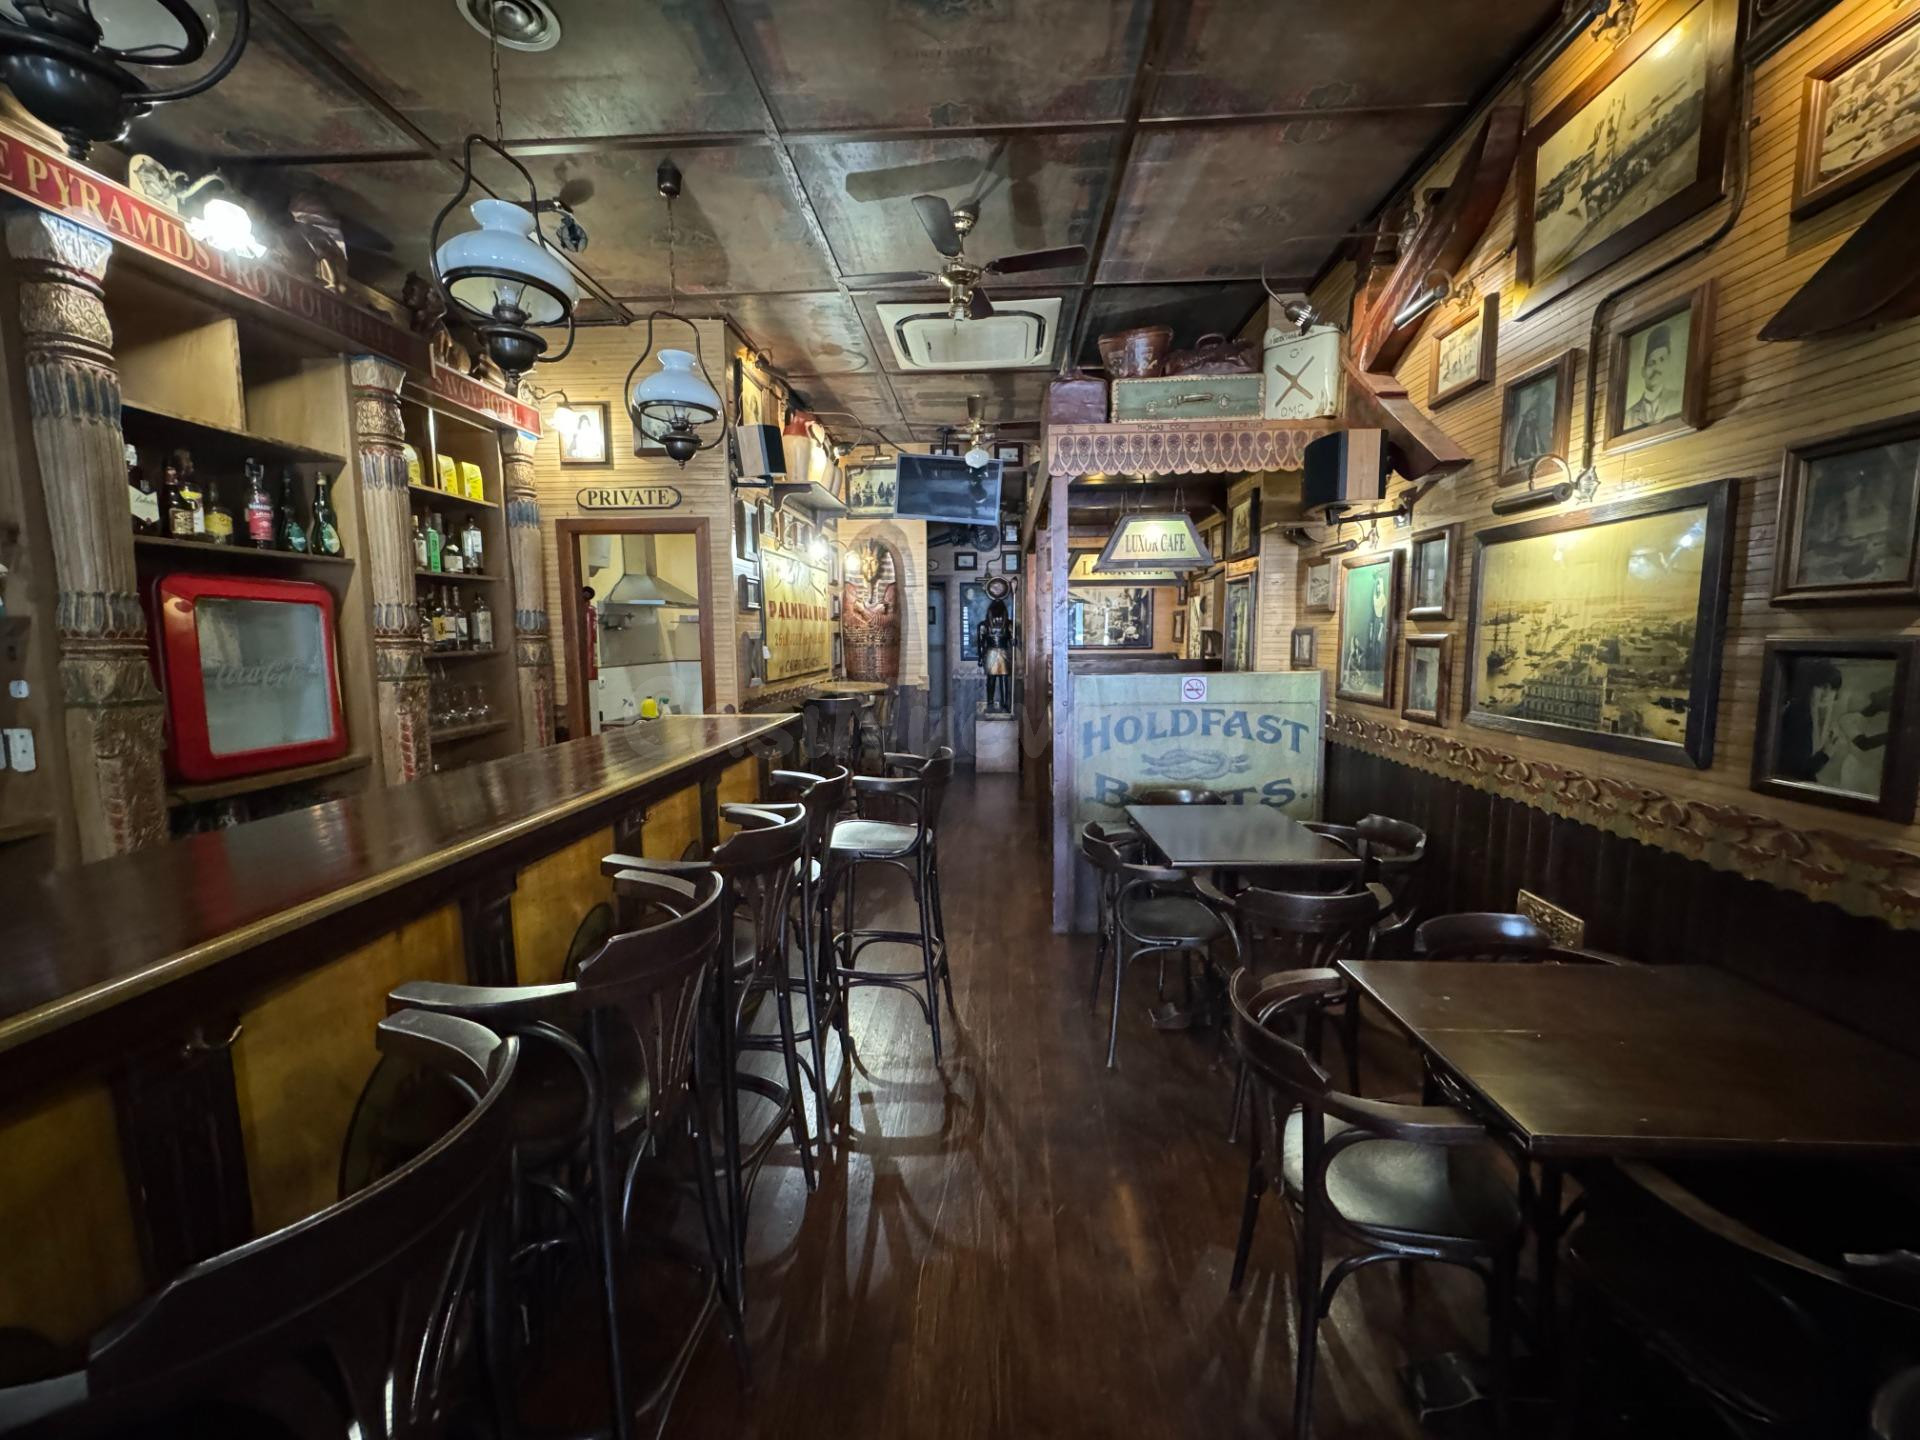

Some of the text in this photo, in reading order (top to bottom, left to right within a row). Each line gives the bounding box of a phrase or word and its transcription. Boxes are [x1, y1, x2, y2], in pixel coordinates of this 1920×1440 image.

[23, 151, 211, 271] PYRAMIDS
[219, 252, 293, 309] FROM
[436, 374, 522, 424] SAVOY HOTEL
[587, 489, 670, 506] PRIVATE
[1124, 533, 1186, 553] LUXOR CAFE
[1082, 708, 1310, 760] HOLDFAST
[1085, 777, 1309, 808] BTS.
